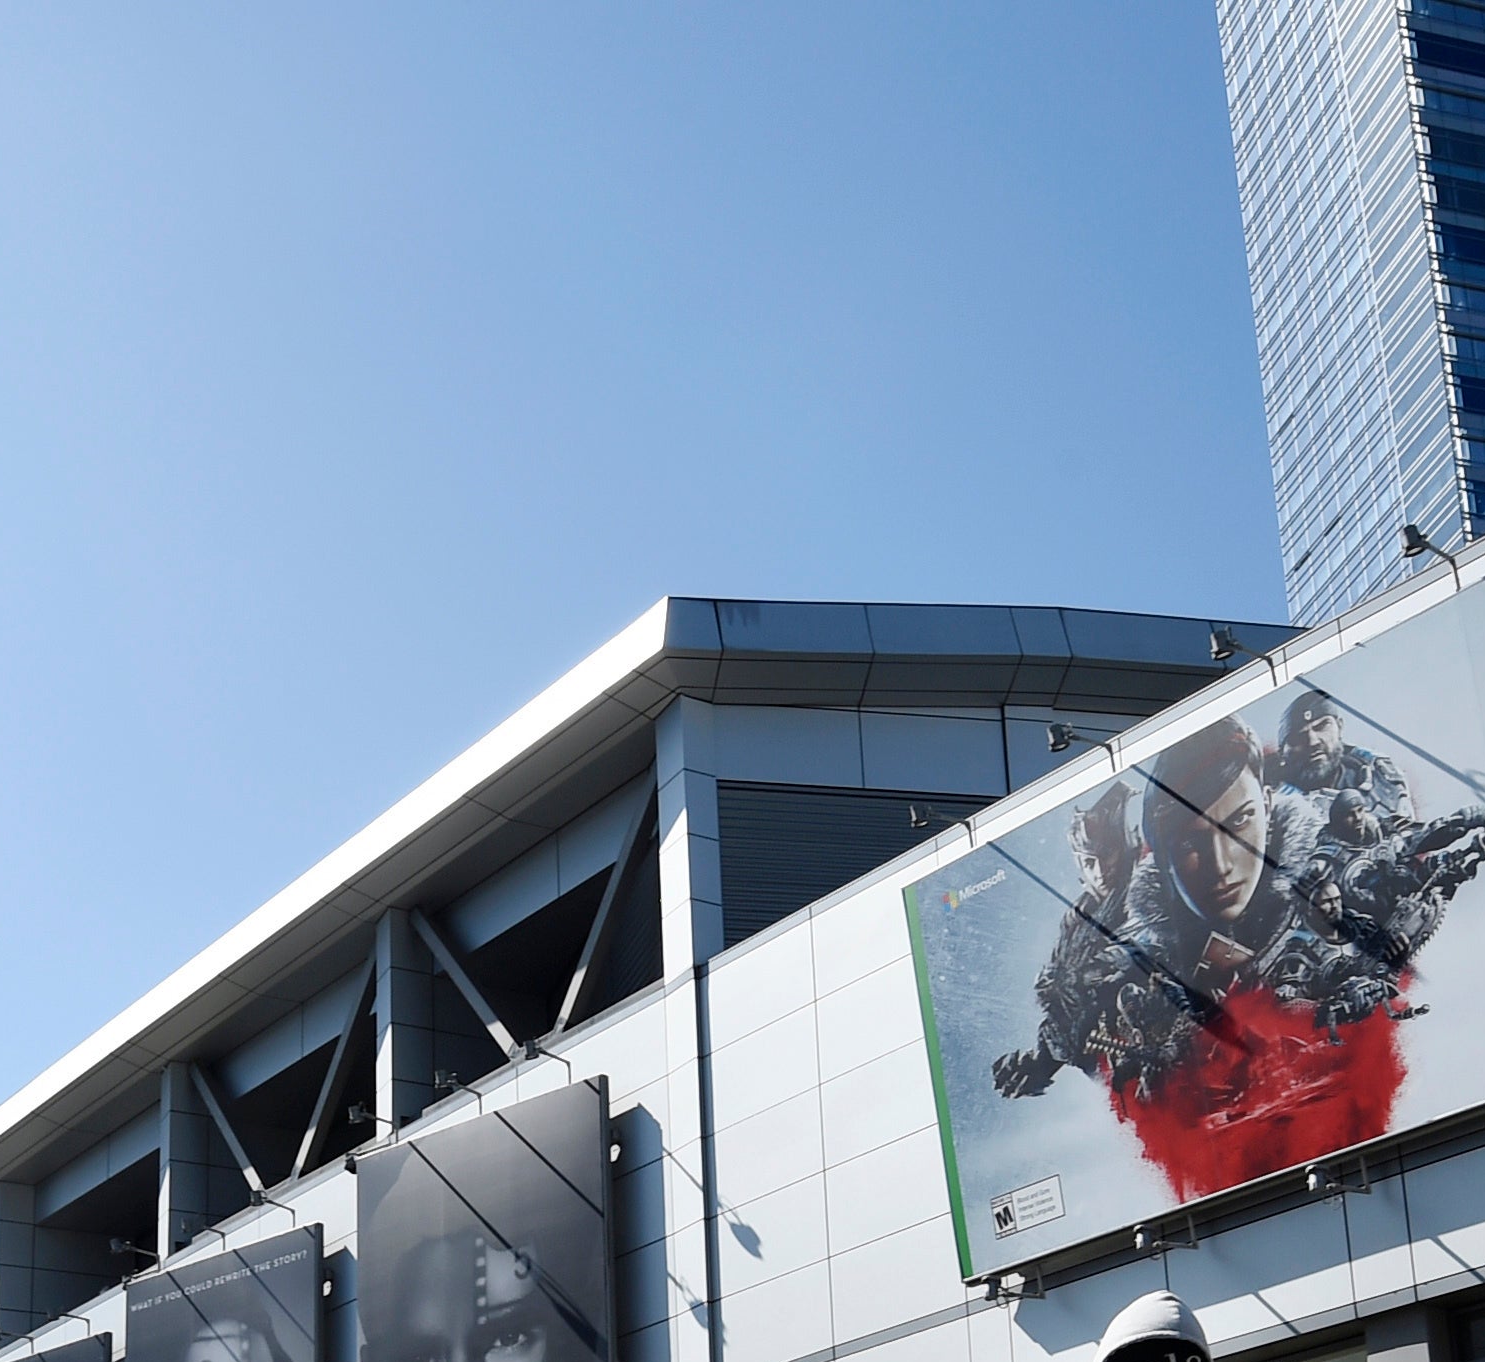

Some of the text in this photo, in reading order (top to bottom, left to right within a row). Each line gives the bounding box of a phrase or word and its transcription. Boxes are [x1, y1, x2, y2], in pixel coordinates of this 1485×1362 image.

[959, 869, 1006, 901] Microsoft
[994, 1206, 1014, 1230] M
[131, 1249, 308, 1312] WHAT IF YOU COULD REWRITE THE STORY?
